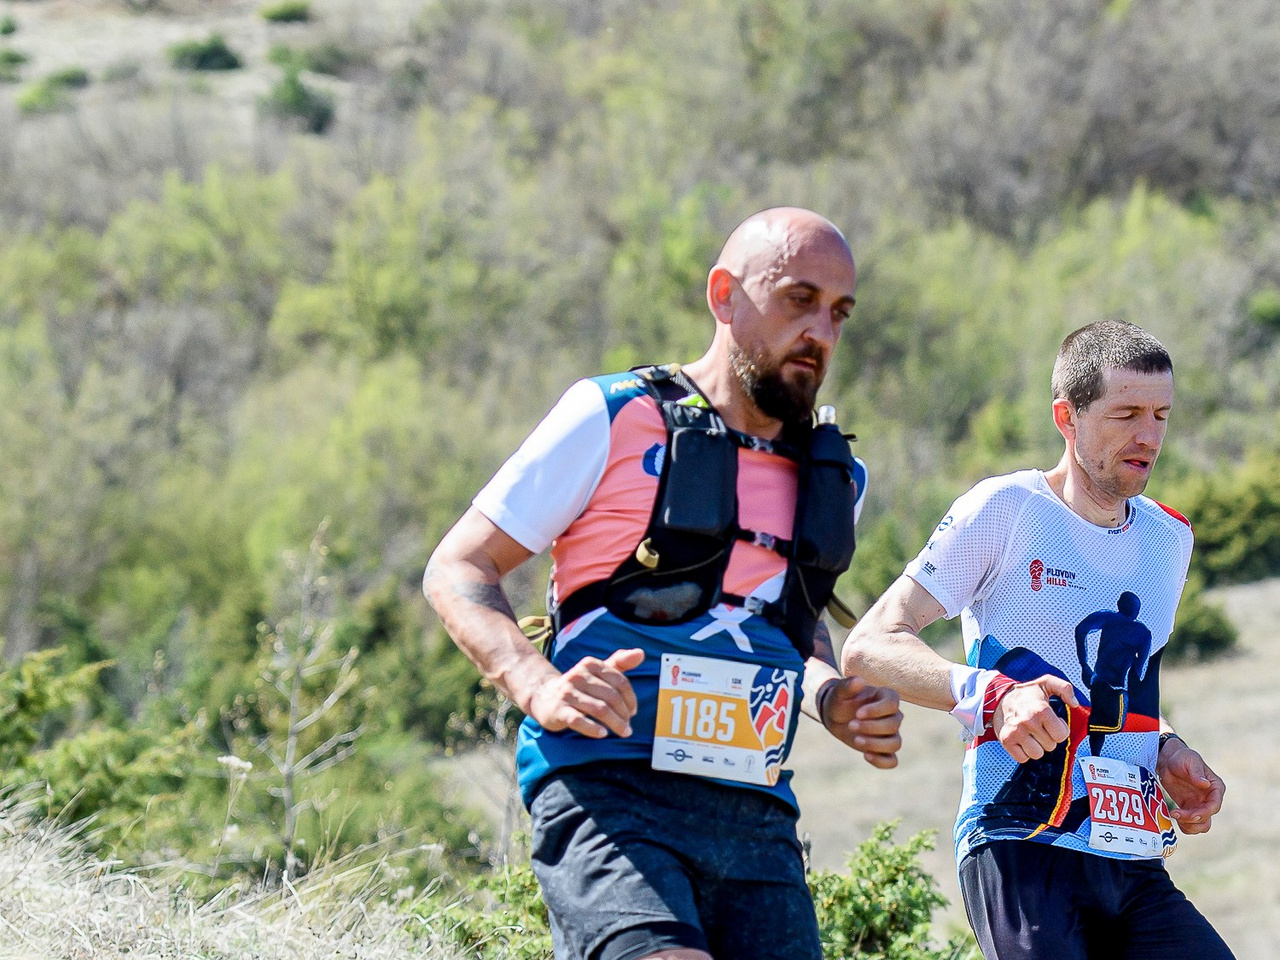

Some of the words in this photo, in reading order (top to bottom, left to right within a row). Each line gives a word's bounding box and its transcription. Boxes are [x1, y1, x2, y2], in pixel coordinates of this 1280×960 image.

[1046, 577, 1067, 587] HILLS
[670, 695, 737, 742] 1185
[1091, 787, 1145, 826] 2329
